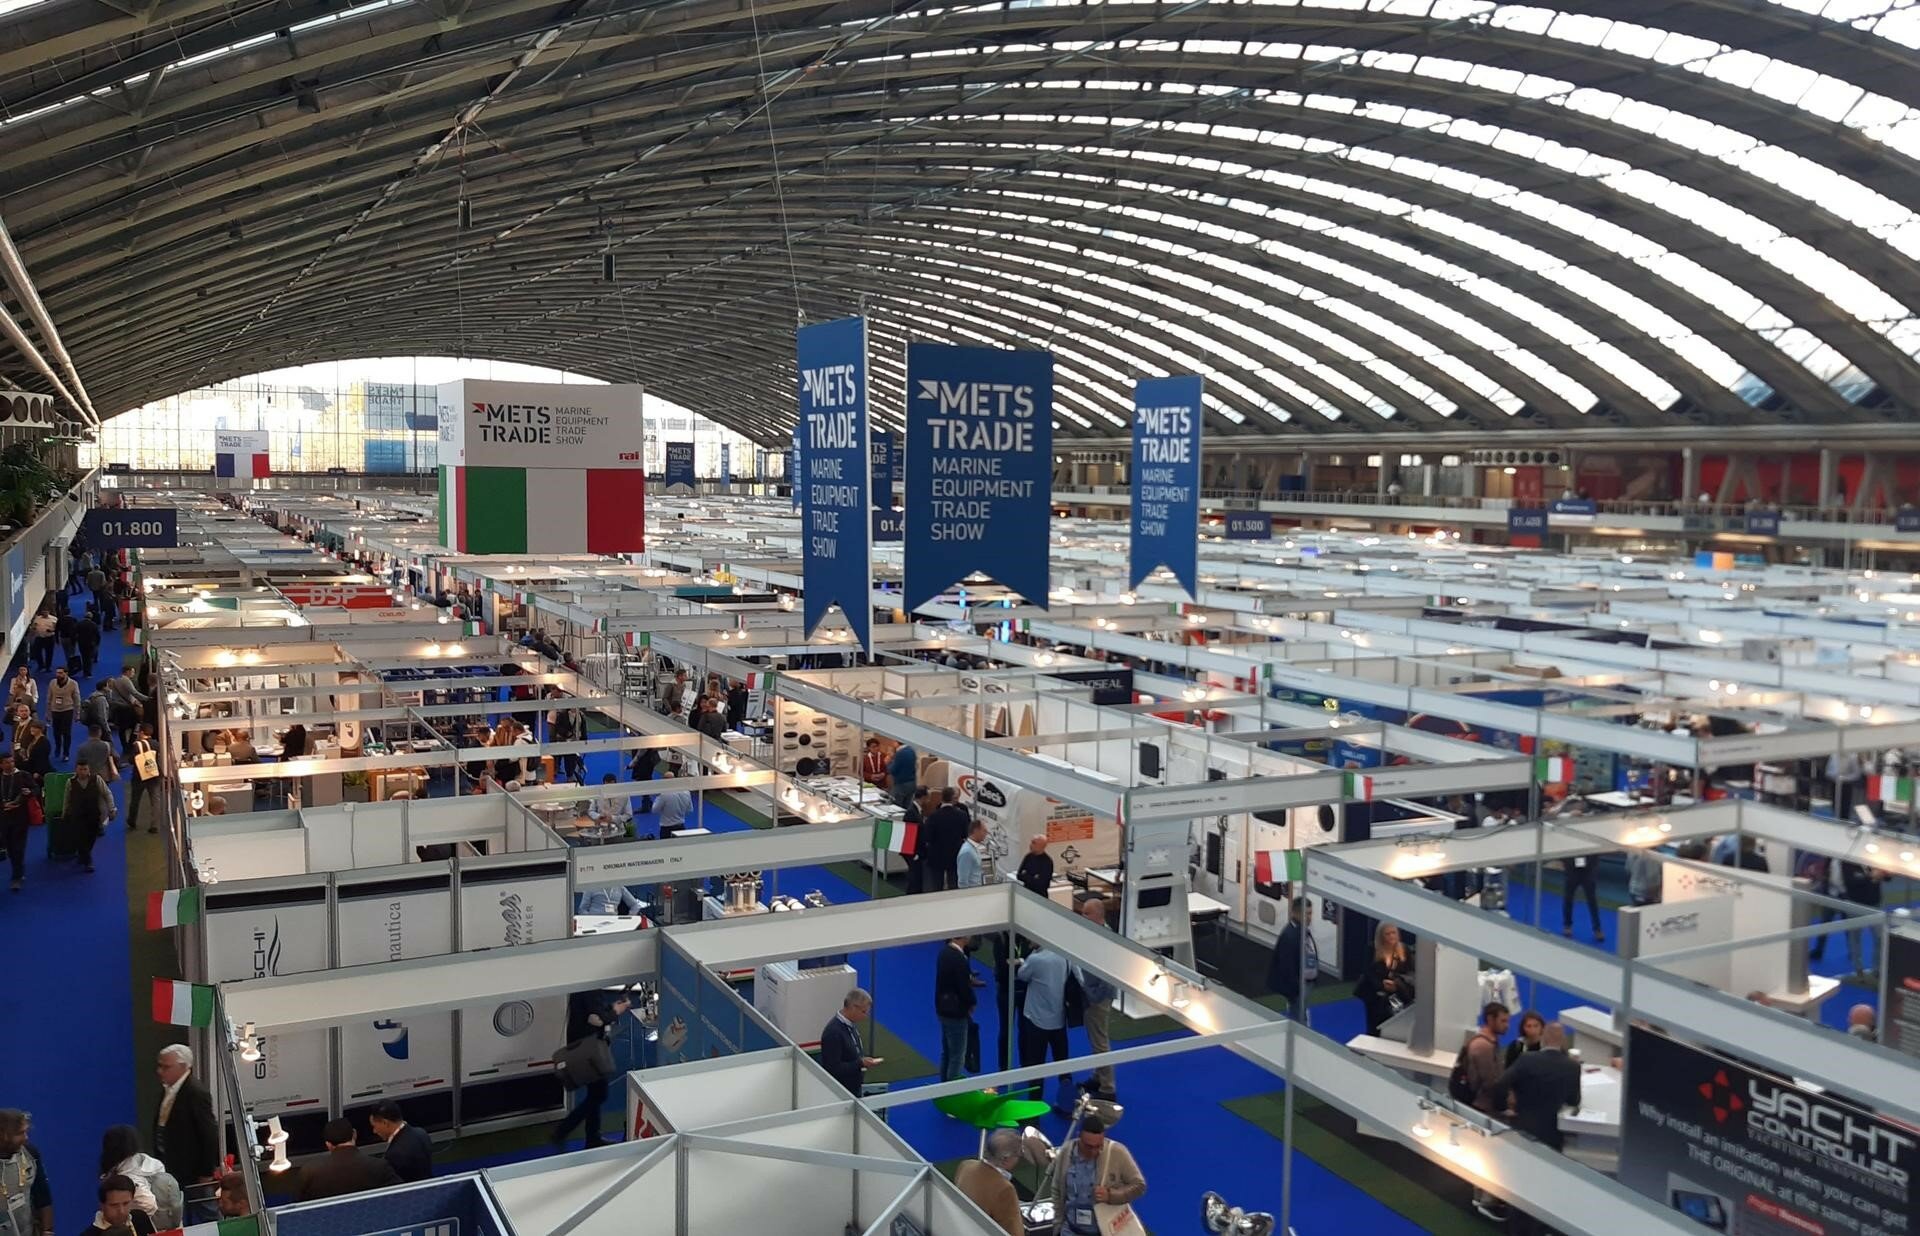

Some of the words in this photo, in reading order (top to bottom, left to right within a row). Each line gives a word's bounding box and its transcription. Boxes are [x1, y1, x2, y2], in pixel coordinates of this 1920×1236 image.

[811, 364, 856, 407] METS
[939, 381, 1034, 418] METS
[486, 404, 550, 424] METS
[556, 407, 592, 416] MARINE
[1145, 406, 1191, 435] METS
[556, 417, 609, 426] EQUIPMENT
[556, 426, 587, 435] TRADE
[807, 412, 857, 449] TRADE
[478, 425, 551, 444] TRADE
[556, 436, 584, 445] SHOW
[927, 419, 1034, 451] TRADE
[619, 451, 639, 461] rai
[1140, 438, 1191, 463] TRADE
[811, 458, 843, 480] MARINE
[932, 457, 1002, 476] MARINE
[1142, 468, 1175, 484] MARINE
[811, 484, 859, 508] EQUIPMENT
[932, 479, 1034, 498] EQUIPMENT
[1141, 485, 1190, 502] EQUIPMENT
[931, 501, 991, 519] TRADE
[1141, 503, 1169, 519] TRADE
[102, 522, 163, 536] 01.800
[811, 510, 839, 533] TRADE
[1140, 521, 1165, 536] SHOW
[1231, 520, 1264, 532] 01.500
[931, 523, 985, 540] SHOW
[812, 536, 837, 559] SHOW
[310, 587, 357, 605] DSP
[627, 858, 664, 868] WATERMAKERS
[1748, 1079, 1910, 1163] YACHT
[1747, 1110, 1909, 1188] CONTROLLER
[1638, 1101, 1665, 1127] Why
[1666, 1113, 1702, 1140] install
[1703, 1132, 1720, 1149] an
[1720, 1137, 1780, 1175] imitation
[1782, 1166, 1822, 1193] when
[1822, 1179, 1851, 1204] you
[1852, 1196, 1880, 1218] can
[1881, 1209, 1908, 1230] get
[1687, 1142, 1712, 1165] THE
[1713, 1155, 1776, 1195] ORIGINAL
[1777, 1186, 1793, 1202] at
[1794, 1192, 1819, 1213] the
[1820, 1205, 1859, 1231] same
